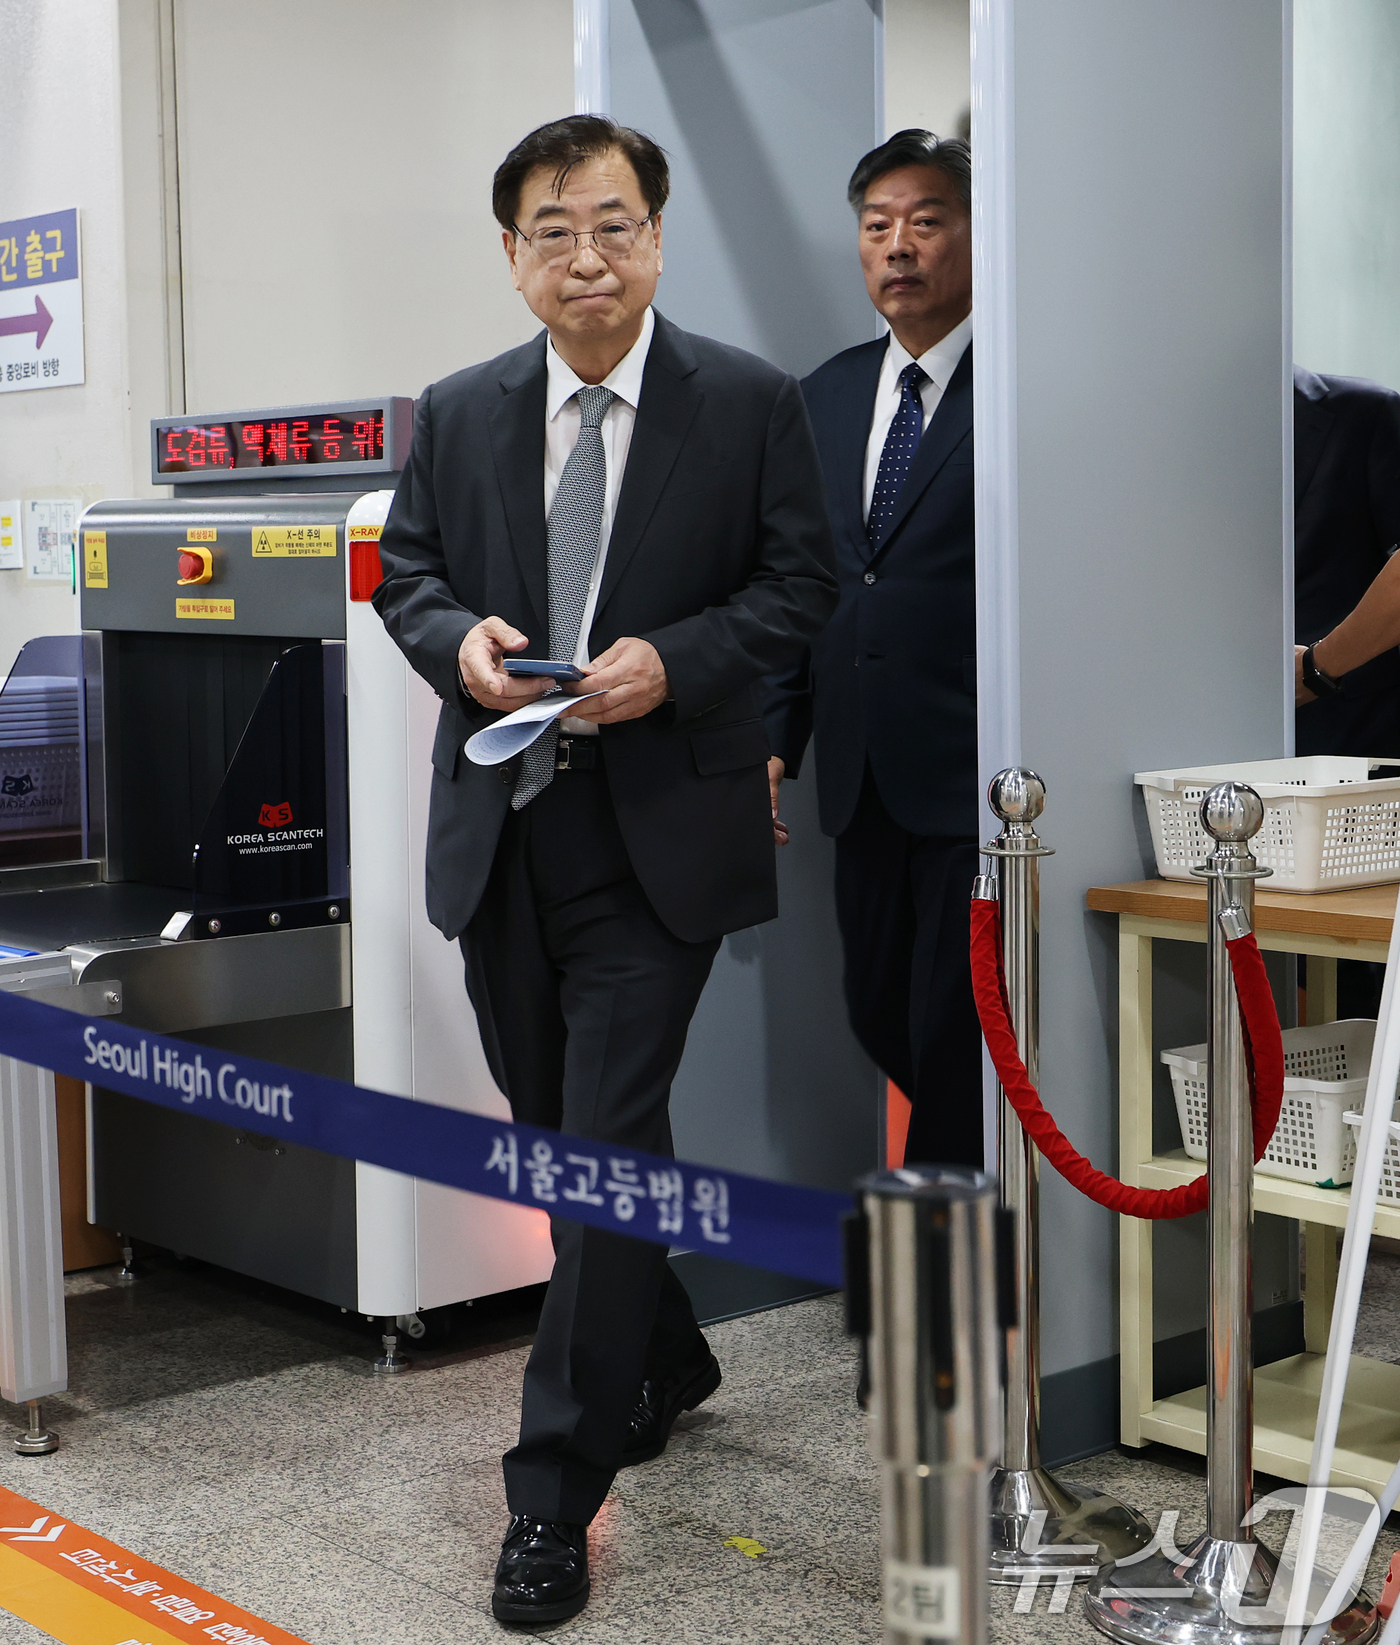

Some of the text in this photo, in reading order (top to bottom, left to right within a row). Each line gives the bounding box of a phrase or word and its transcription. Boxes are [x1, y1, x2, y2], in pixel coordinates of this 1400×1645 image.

[24, 229, 65, 279] 출구
[7, 361, 39, 381] 중앙로비
[43, 358, 59, 377] 방향
[165, 426, 234, 469] 도검류,
[319, 419, 344, 459] 등
[190, 530, 214, 540] 비상정지
[287, 529, 321, 540] X-선 주의
[350, 528, 380, 537] X-RAY
[227, 828, 324, 844] KOREA SCANTECH
[239, 842, 312, 855] www.koreascan.com
[84, 1025, 294, 1123] Seoul High Court
[484, 1131, 731, 1244] 서울고등법원
[892, 1576, 945, 1624] 2팀
